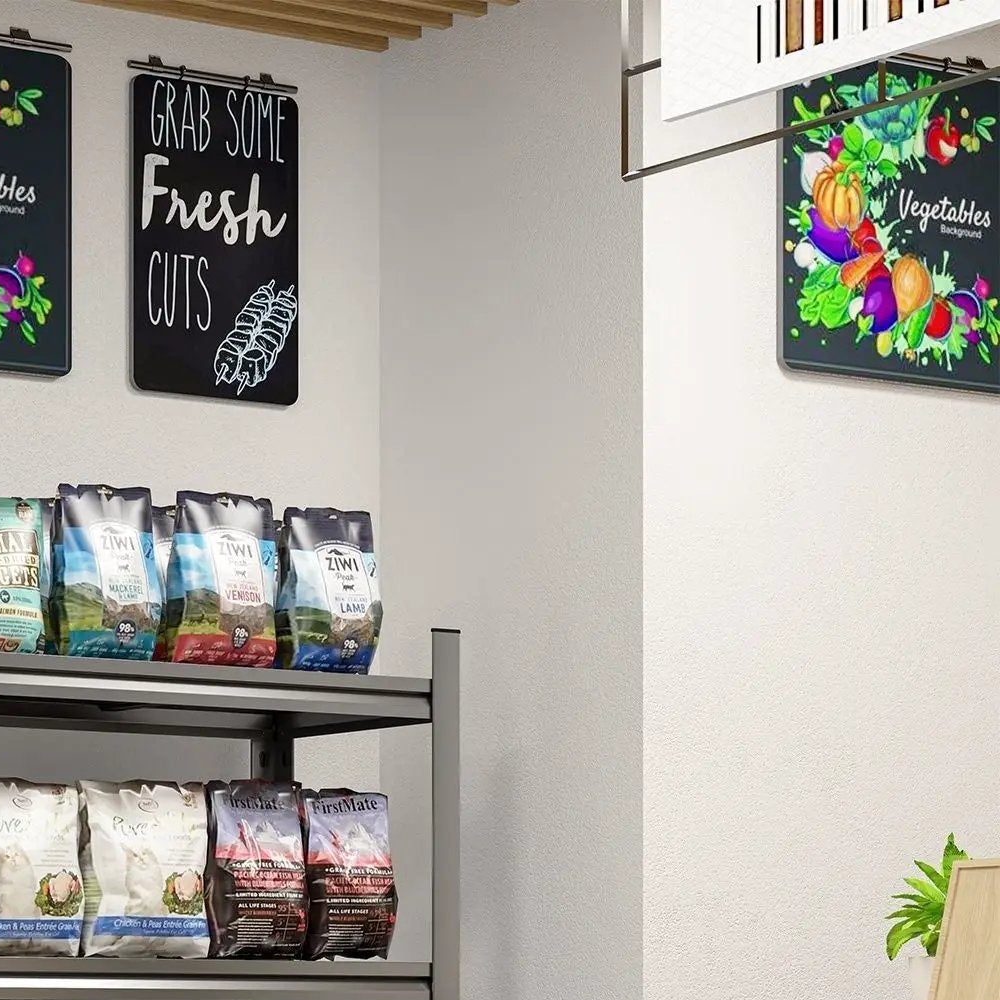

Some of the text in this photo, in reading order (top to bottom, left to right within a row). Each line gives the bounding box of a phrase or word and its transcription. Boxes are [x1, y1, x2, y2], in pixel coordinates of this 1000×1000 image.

[150, 80, 287, 163] GRAB SOME
[141, 154, 286, 245] Fresh
[899, 188, 991, 232] Vegetables
[940, 224, 982, 239] Background
[148, 251, 211, 331] CUTS
[100, 535, 135, 551] ZIWI
[218, 541, 253, 559] ZIWI
[325, 557, 359, 571] ZIWI
[109, 584, 144, 595] MACKEREL
[225, 590, 261, 603] VENISON
[340, 603, 366, 613] LAMB
[313, 799, 379, 815] FirstMate
[19, 922, 34, 930] Peas
[114, 919, 141, 928] Chicken
[148, 920, 162, 928] Peas
